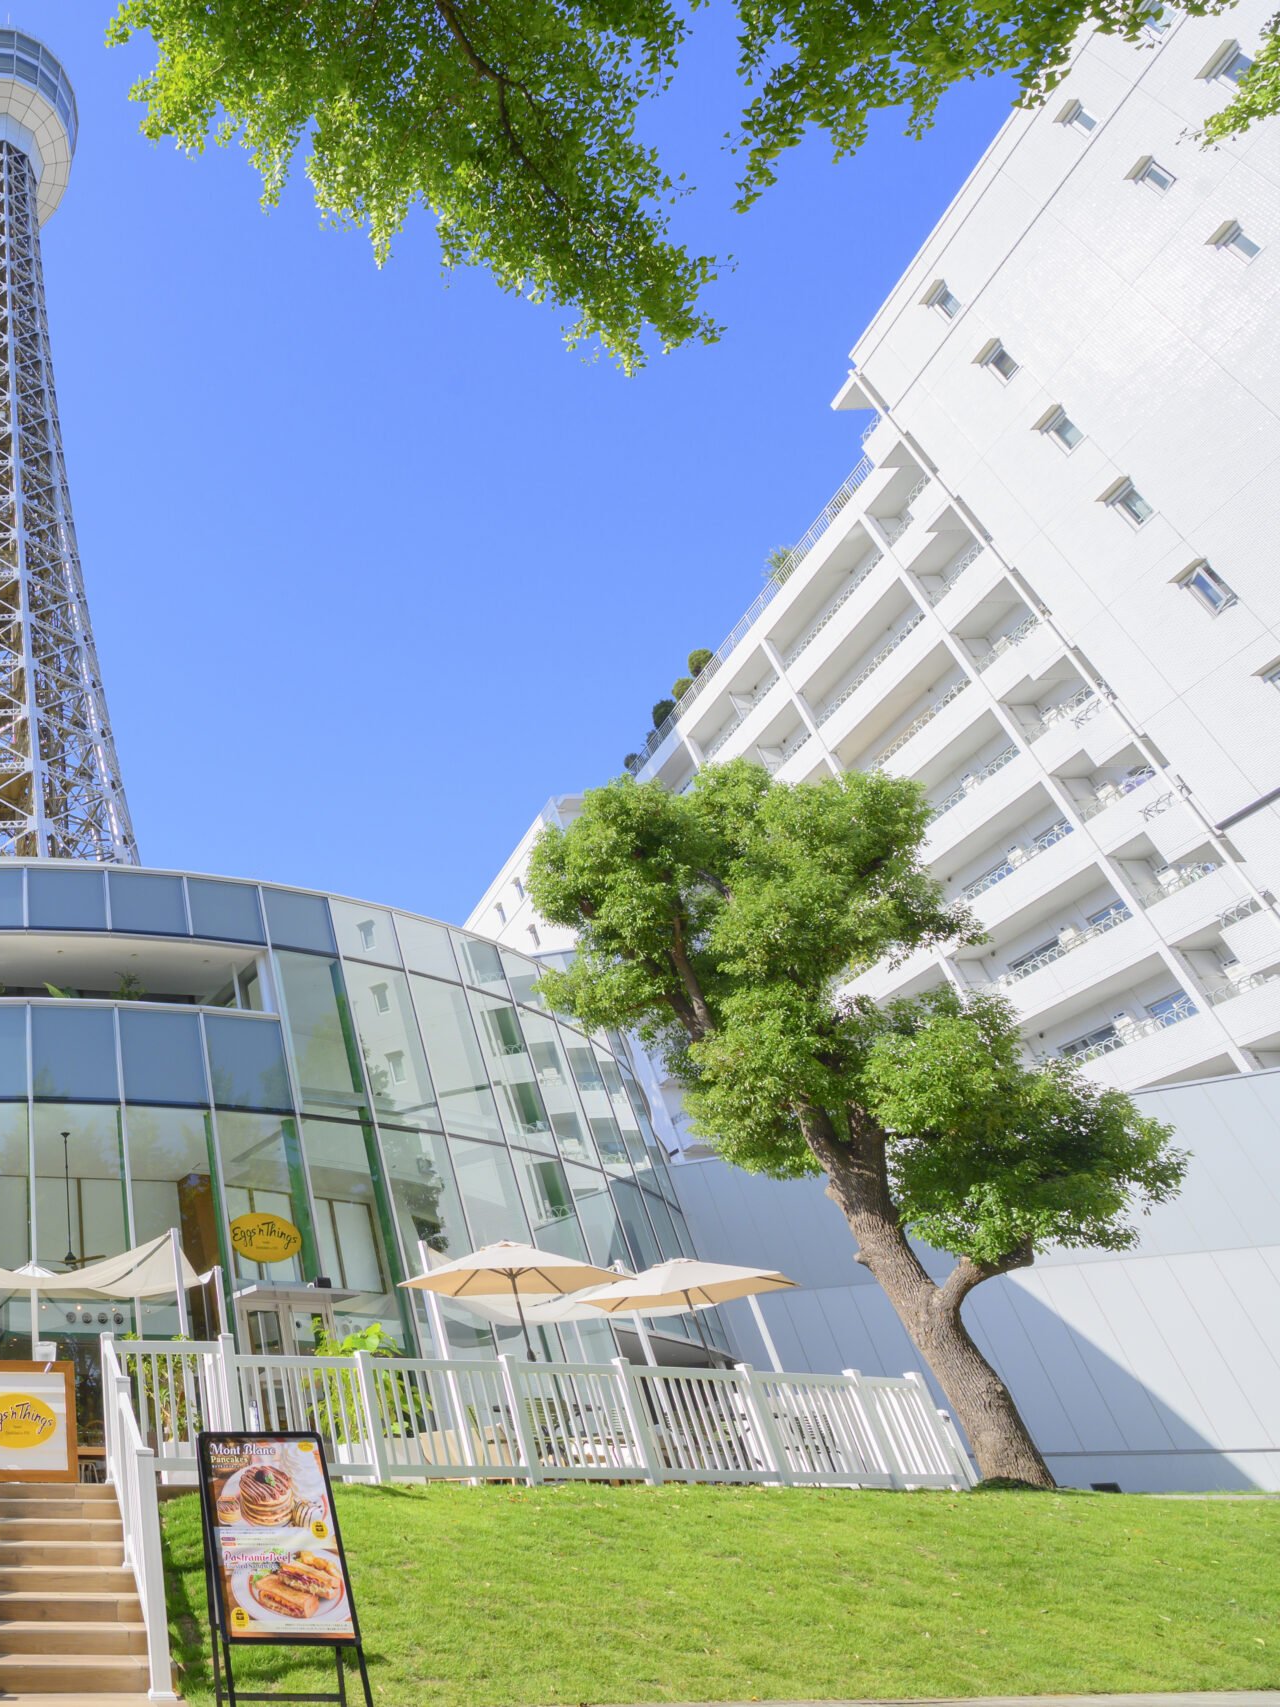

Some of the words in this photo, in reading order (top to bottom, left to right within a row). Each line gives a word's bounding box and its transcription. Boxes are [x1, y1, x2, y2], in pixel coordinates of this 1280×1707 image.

[262, 1220, 298, 1250] Things
[15, 1401, 54, 1434] Things
[209, 1443, 240, 1455] Mont
[242, 1443, 277, 1455] Blanc
[210, 1455, 249, 1463] Pancakes
